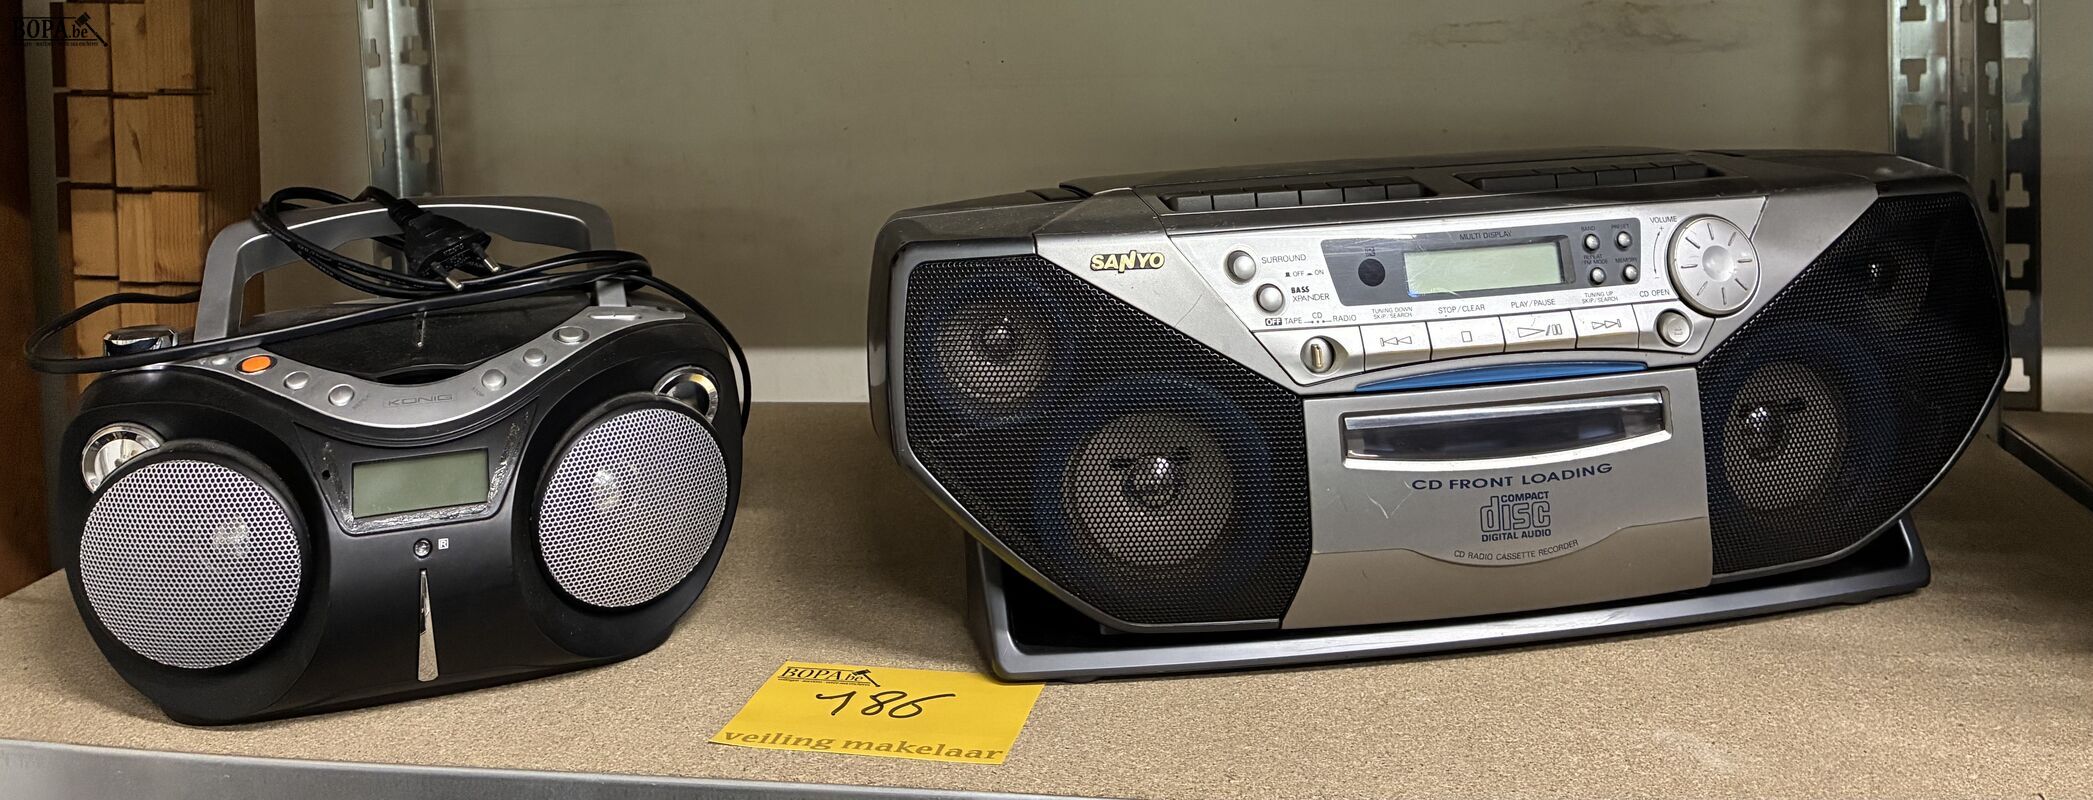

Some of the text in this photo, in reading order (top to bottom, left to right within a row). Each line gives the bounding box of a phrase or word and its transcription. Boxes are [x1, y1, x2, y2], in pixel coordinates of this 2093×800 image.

[1650, 215, 1678, 224] VOLUME
[1459, 230, 1513, 241] MULTI DISPLAY
[1090, 250, 1165, 273] SANYO
[1261, 253, 1307, 265] SURROUND
[1290, 285, 1310, 294] BASS
[1639, 288, 1670, 298] CD OPEN
[1292, 292, 1330, 303] XPANDER
[1511, 298, 1556, 309] PLAY/PAUSE
[1438, 303, 1486, 315] STOP/CLEAR
[1266, 311, 1357, 326] OFF TAPE CD RADIO
[1412, 463, 1613, 490] CD FRONT LOADING
[1501, 491, 1550, 503] COMPACT
[1481, 528, 1552, 543] DIGITAL AUDIO
[1454, 539, 1579, 561] CD RADIO CASSETTE RECORDER
[815, 690, 957, 719] 186
[724, 731, 1005, 760] veiling makelaar
